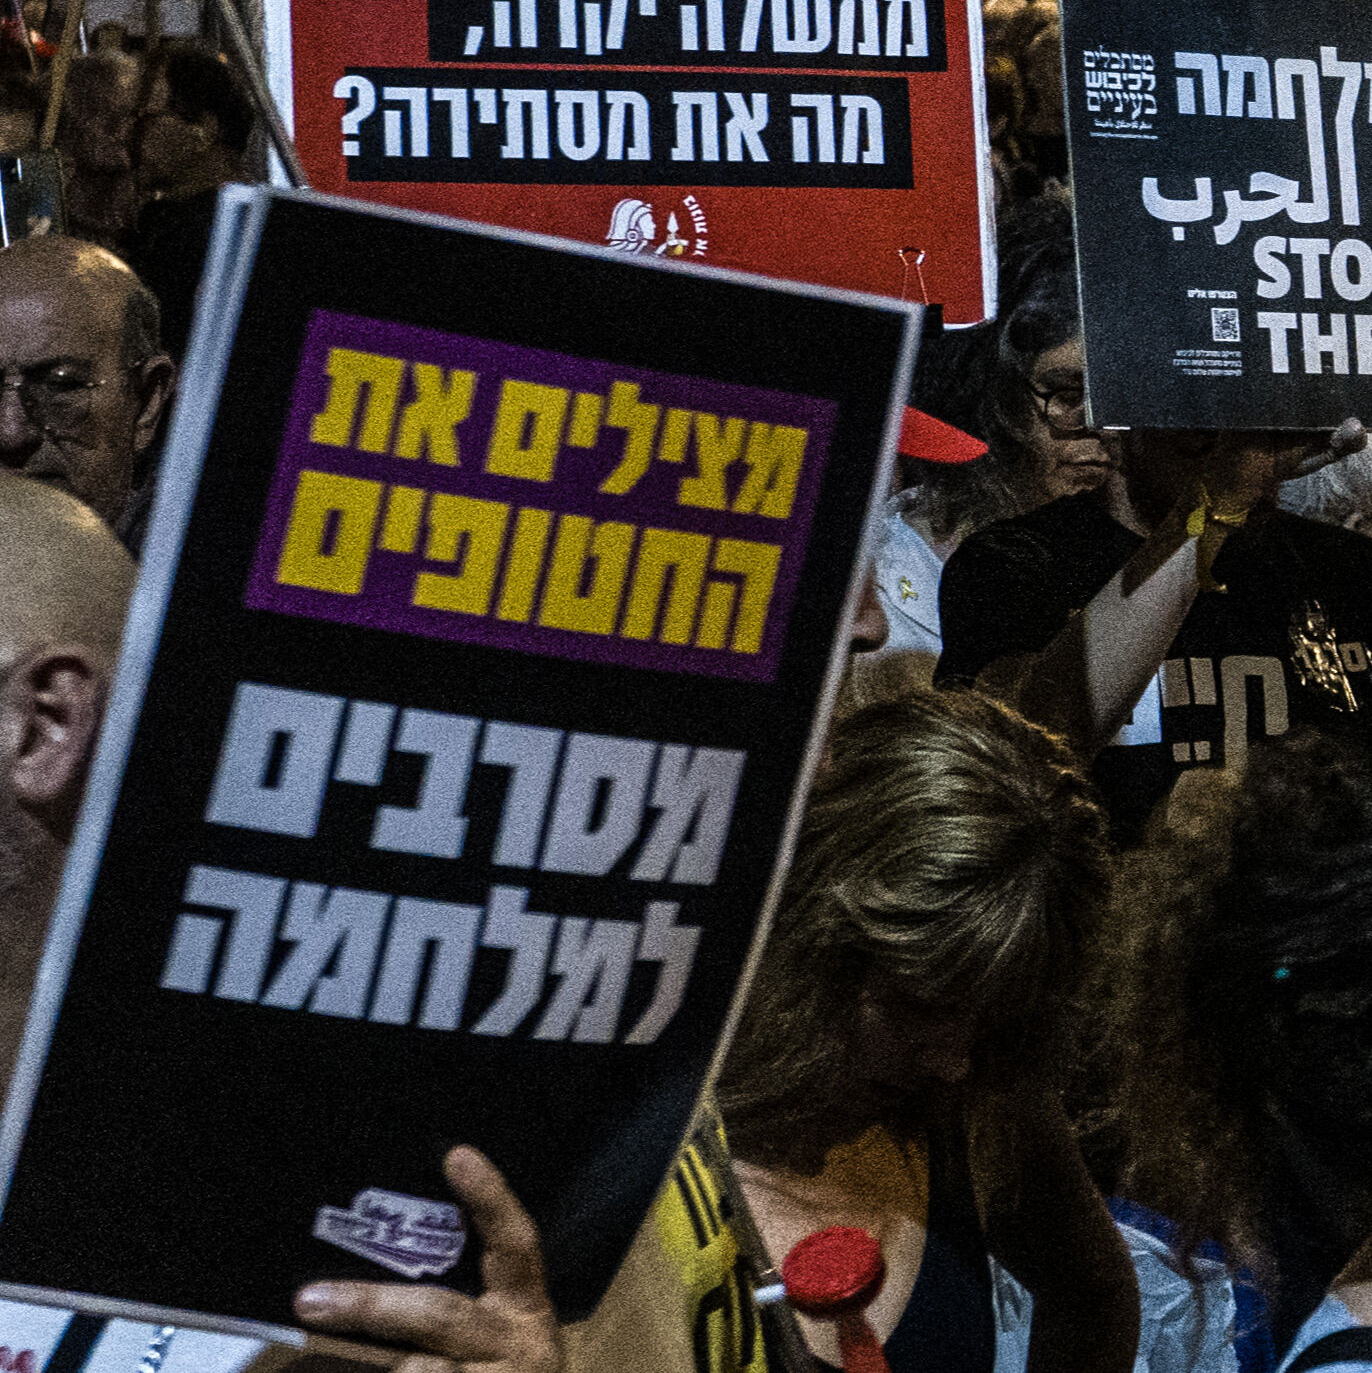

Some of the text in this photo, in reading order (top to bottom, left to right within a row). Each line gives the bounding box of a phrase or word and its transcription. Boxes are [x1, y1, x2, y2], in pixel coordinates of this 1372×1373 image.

[1083, 44, 1155, 71] מסתכלים
[1084, 71, 1156, 91] לכיבוש
[1086, 90, 1158, 120] בעיניים
[333, 74, 886, 166] מה את מסתירה?
[1141, 127, 1362, 245] الحرب
[309, 346, 809, 521] מצילים את
[275, 469, 784, 656] החטופים
[204, 681, 748, 887] מסרבים
[159, 864, 702, 1046] למלחמה
